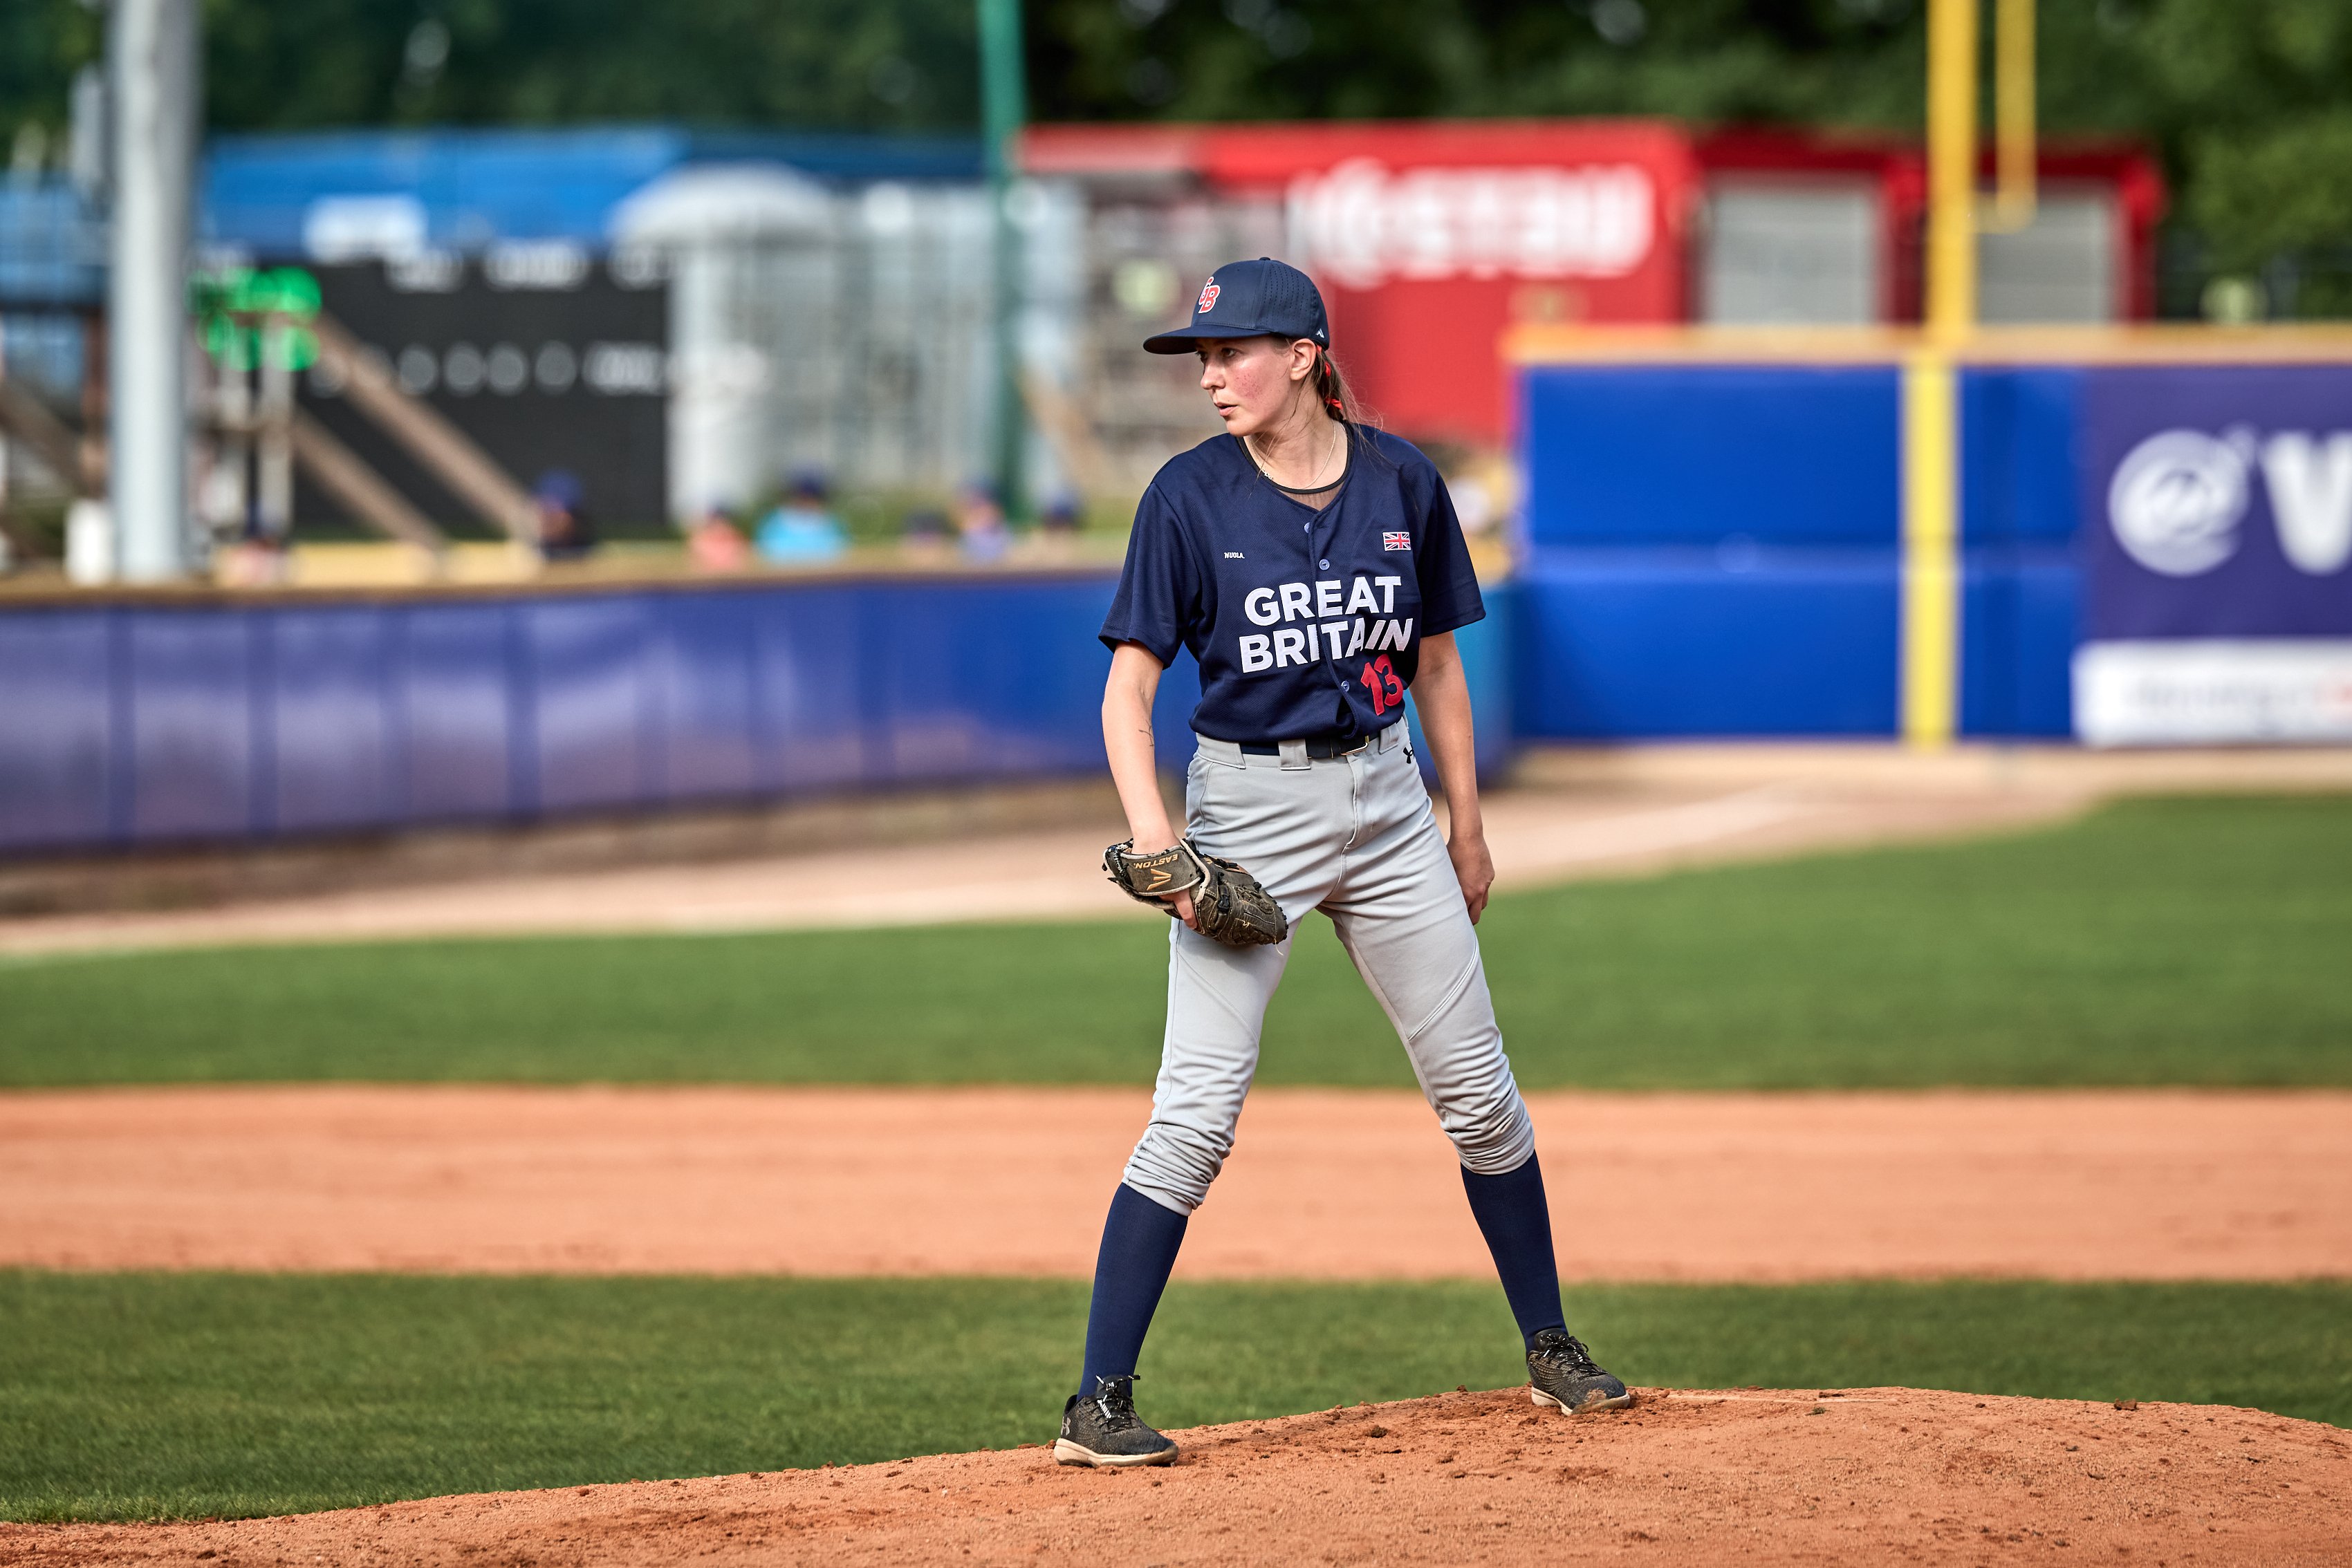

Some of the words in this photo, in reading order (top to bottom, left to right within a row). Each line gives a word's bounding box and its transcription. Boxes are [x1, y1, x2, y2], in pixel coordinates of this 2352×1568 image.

[1244, 576, 1402, 626] GREAT
[1239, 617, 1413, 673] BRITAIN
[1360, 653, 1403, 716] 13
[1134, 854, 1178, 869] EASTON
